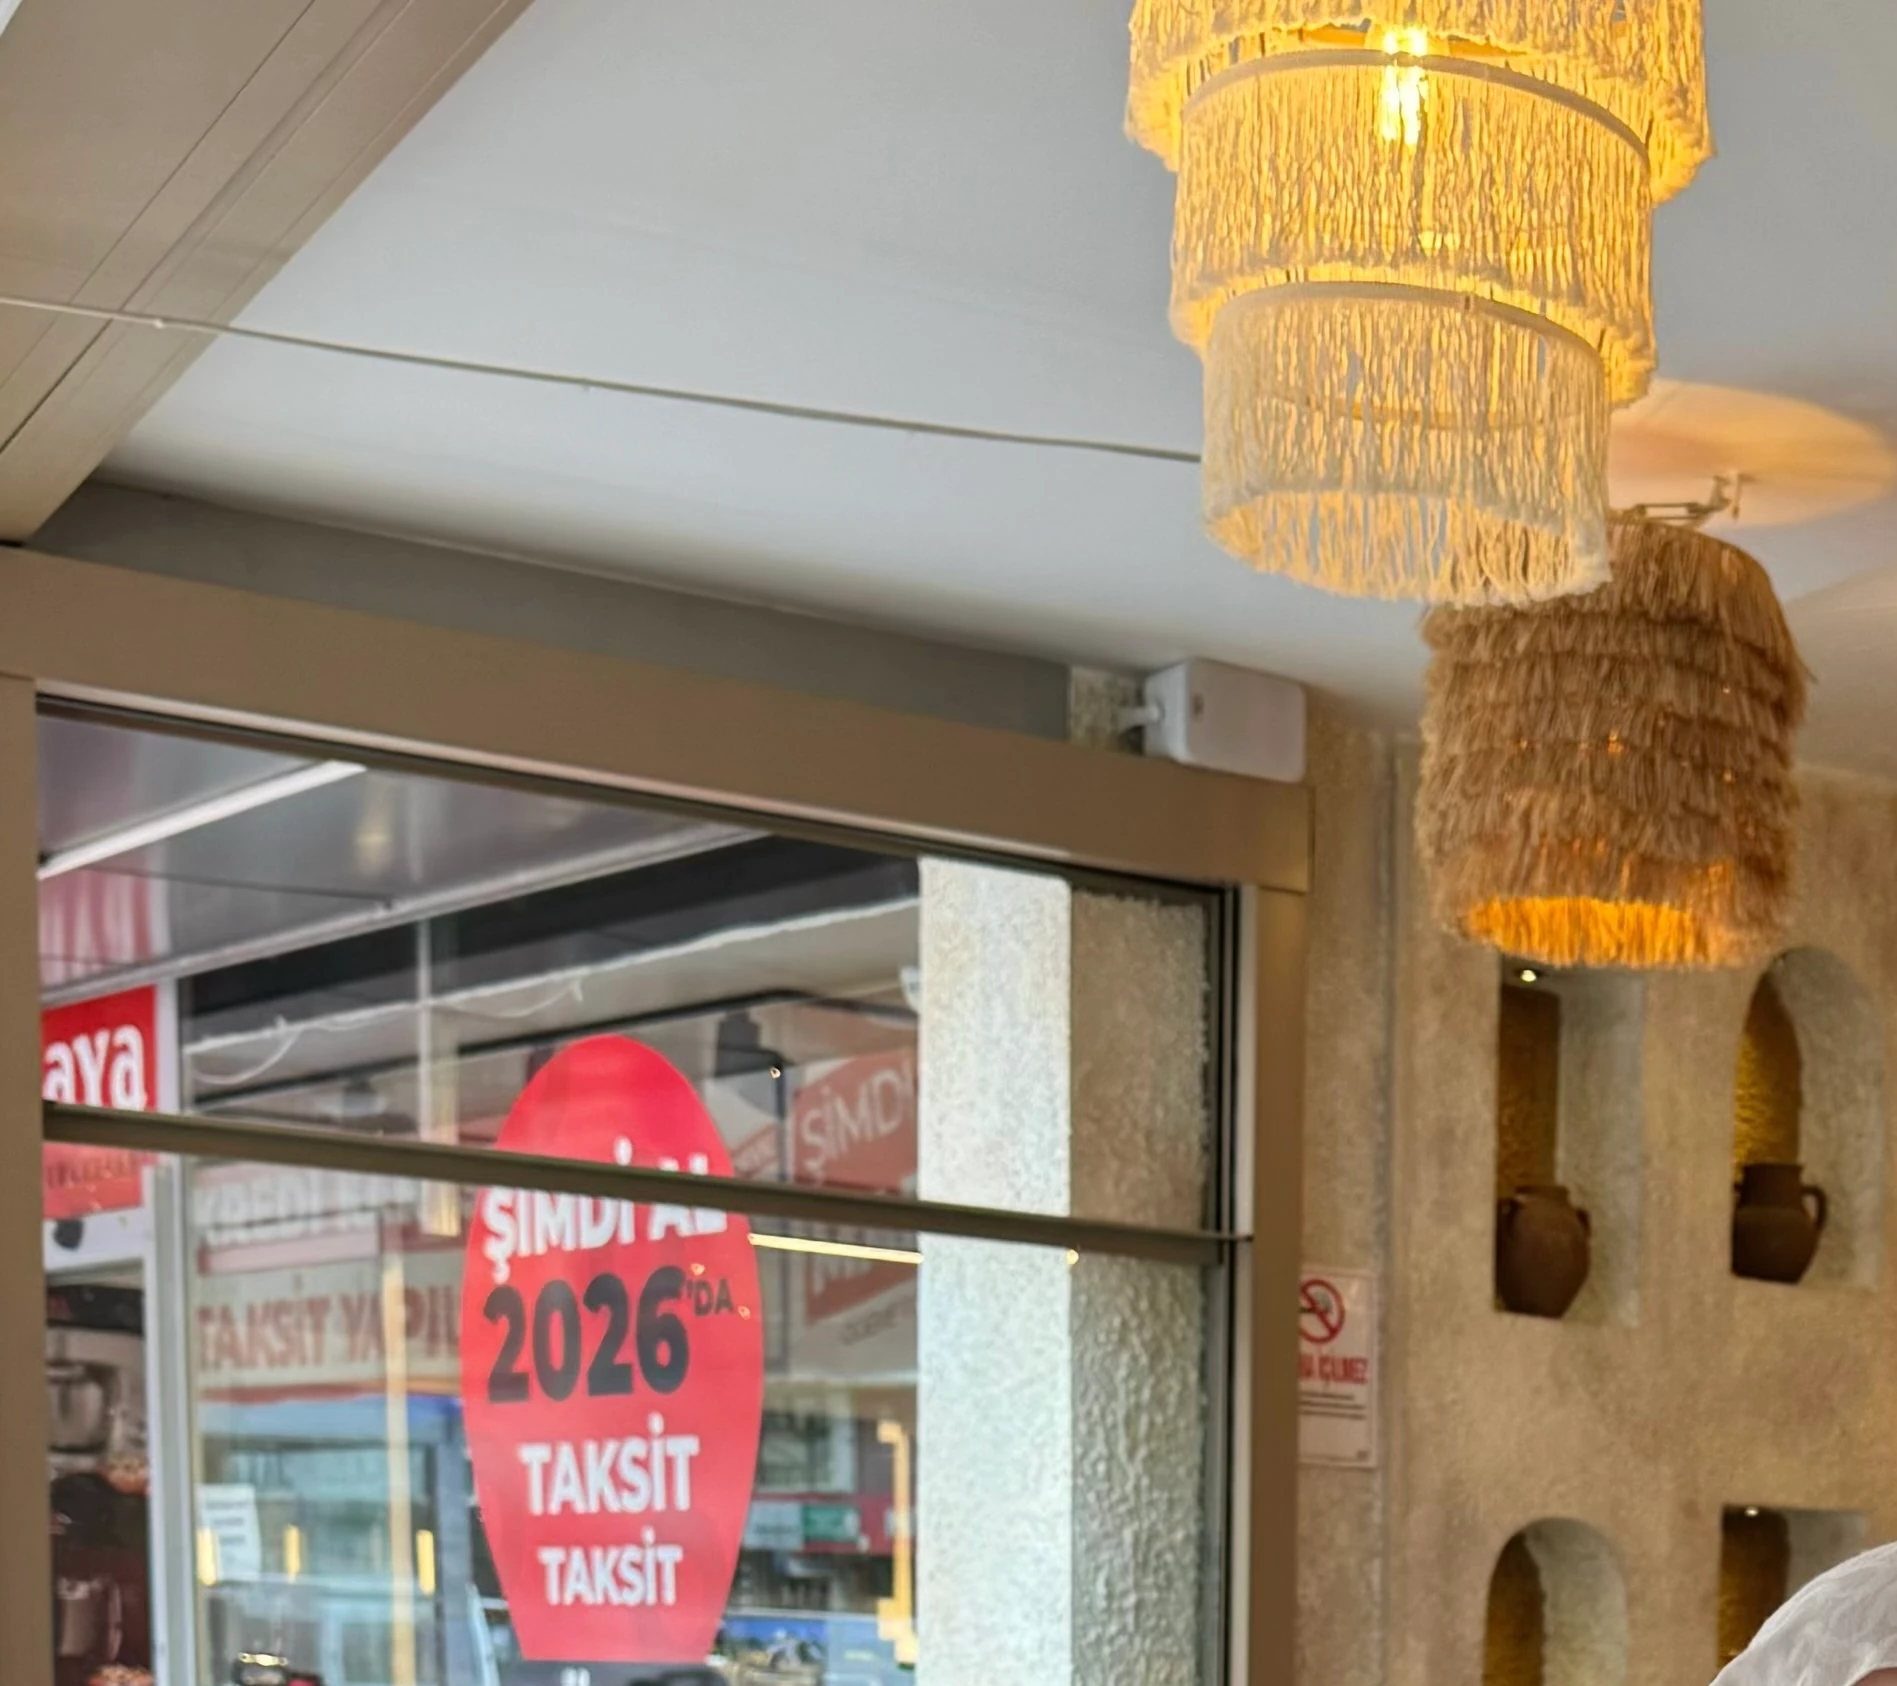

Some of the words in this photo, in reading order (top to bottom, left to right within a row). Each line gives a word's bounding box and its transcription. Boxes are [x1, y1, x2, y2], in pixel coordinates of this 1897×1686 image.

[197, 1273, 330, 1370] TAKSİT
[517, 1411, 700, 1516] TAKSİT
[537, 1525, 683, 1607] TAKSİT
